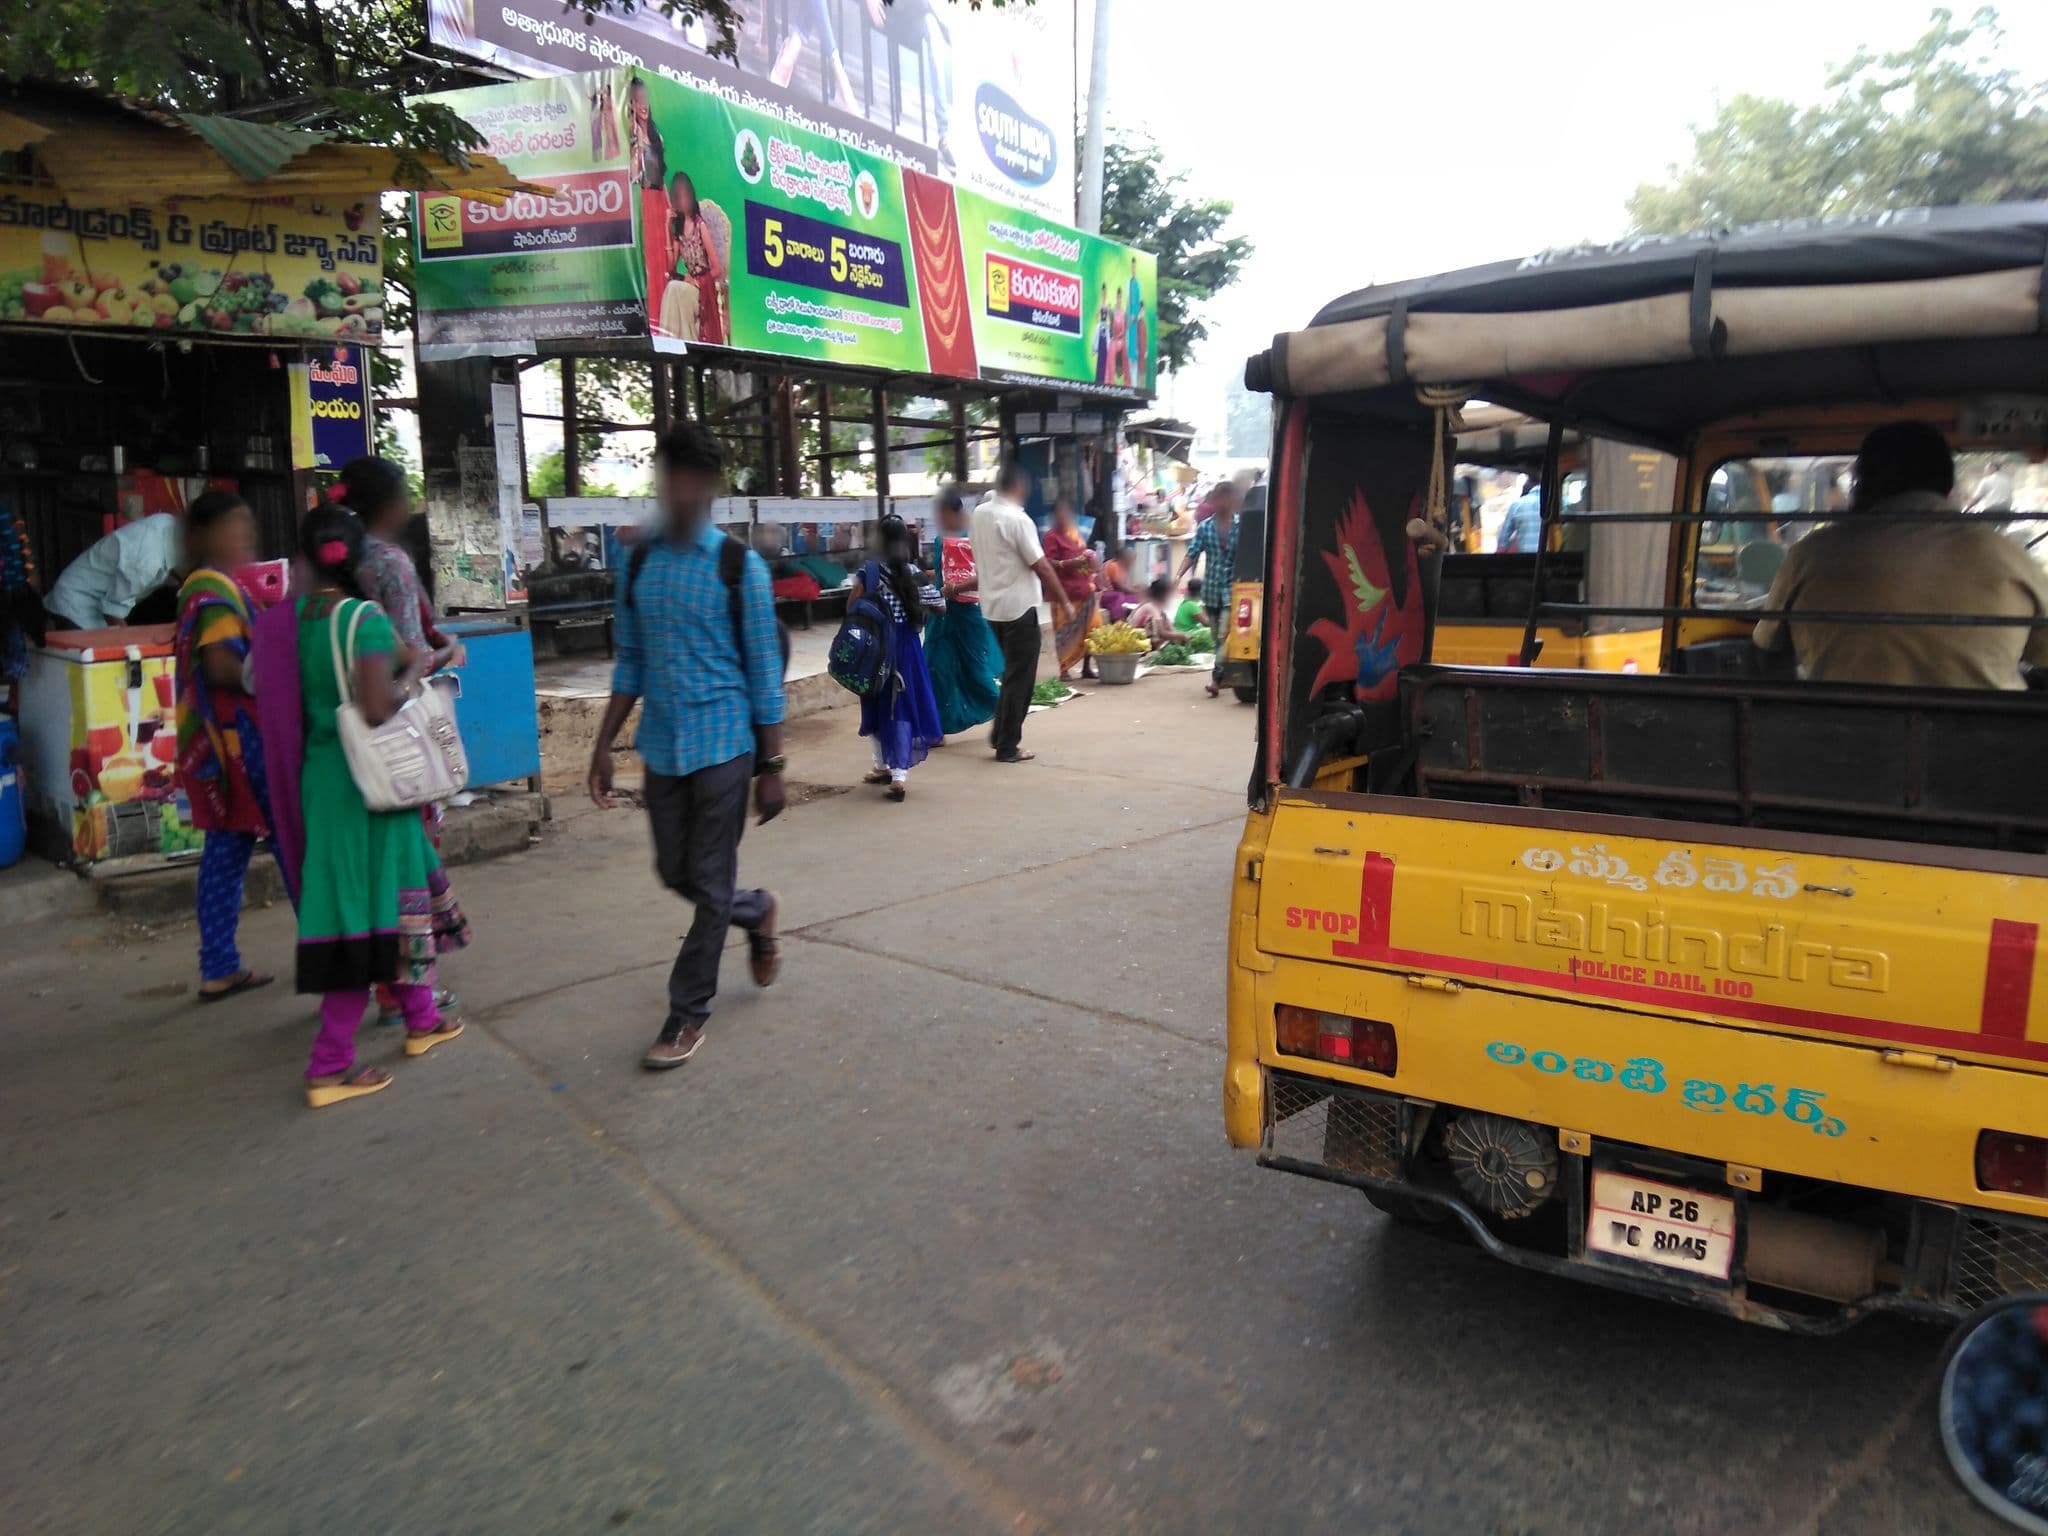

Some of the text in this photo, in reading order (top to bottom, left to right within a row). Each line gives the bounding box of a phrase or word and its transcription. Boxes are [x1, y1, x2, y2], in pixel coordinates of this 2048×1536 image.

[979, 102, 1051, 160] SOUTH INDIA
[167, 213, 193, 245] &
[764, 218, 885, 282] 5 వారాలు 5 బంగారు
[1011, 268, 1079, 310] కందుకూరి
[1286, 906, 1358, 935] STOP
[1460, 887, 1890, 994] mahindra
[1568, 957, 1753, 999] POLICE DAIL 100
[1631, 1191, 1699, 1222] AP 26
[1653, 1230, 1707, 1261] 8045
